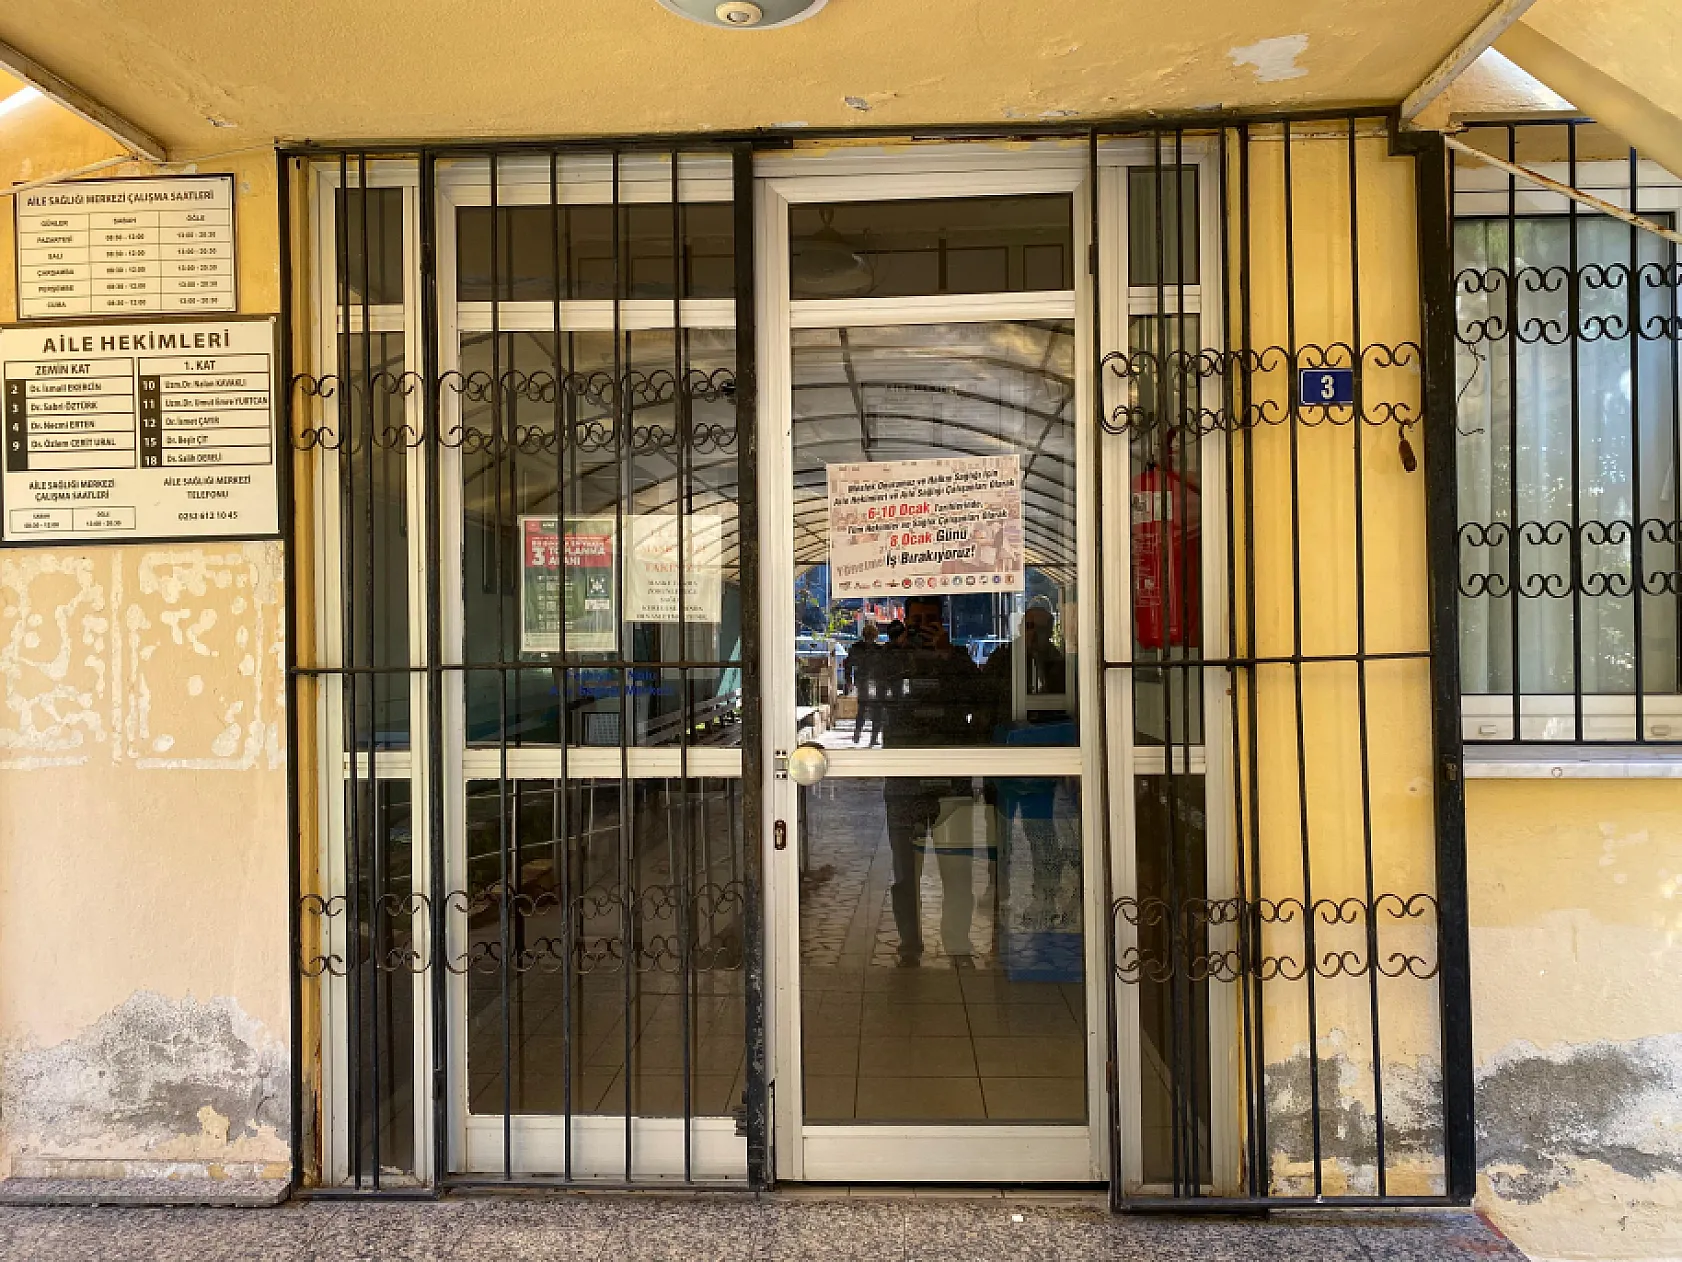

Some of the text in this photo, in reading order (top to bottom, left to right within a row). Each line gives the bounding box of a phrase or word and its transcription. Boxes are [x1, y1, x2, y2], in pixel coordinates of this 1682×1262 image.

[27, 189, 214, 207] AİLE SAĞLIĞI MERKEZİ ÇALIŞMA SAATLERİ
[42, 329, 230, 353] AİLE HEKİMLERİ
[34, 362, 91, 376] ZEMİN KAT
[183, 360, 216, 371] 1. KAT
[11, 384, 19, 395] 2
[143, 380, 156, 391] 10
[1320, 374, 1335, 400] 3
[11, 403, 19, 414] 3
[65, 400, 98, 411] ÖZTÜRK
[143, 398, 156, 409] 11
[143, 418, 157, 428] 12
[12, 441, 19, 451] 9
[144, 437, 157, 447] 15
[145, 455, 157, 466] 18
[29, 478, 114, 490] AİLE SAĞLIĞI MERKEZİ
[163, 474, 251, 487] AİLE SAĞLIĞI MERKEZİ
[35, 489, 109, 502] ÇALIŞMA SAATLERİ
[186, 490, 229, 499] TELEFONU
[227, 510, 239, 520] 45
[868, 504, 897, 520] 6-10
[899, 500, 931, 516] Ocak
[890, 527, 967, 547] 8 Ocak Günü
[531, 547, 546, 566] 3
[886, 550, 897, 569] İş
[901, 543, 976, 565] Bırakıyoruz!
